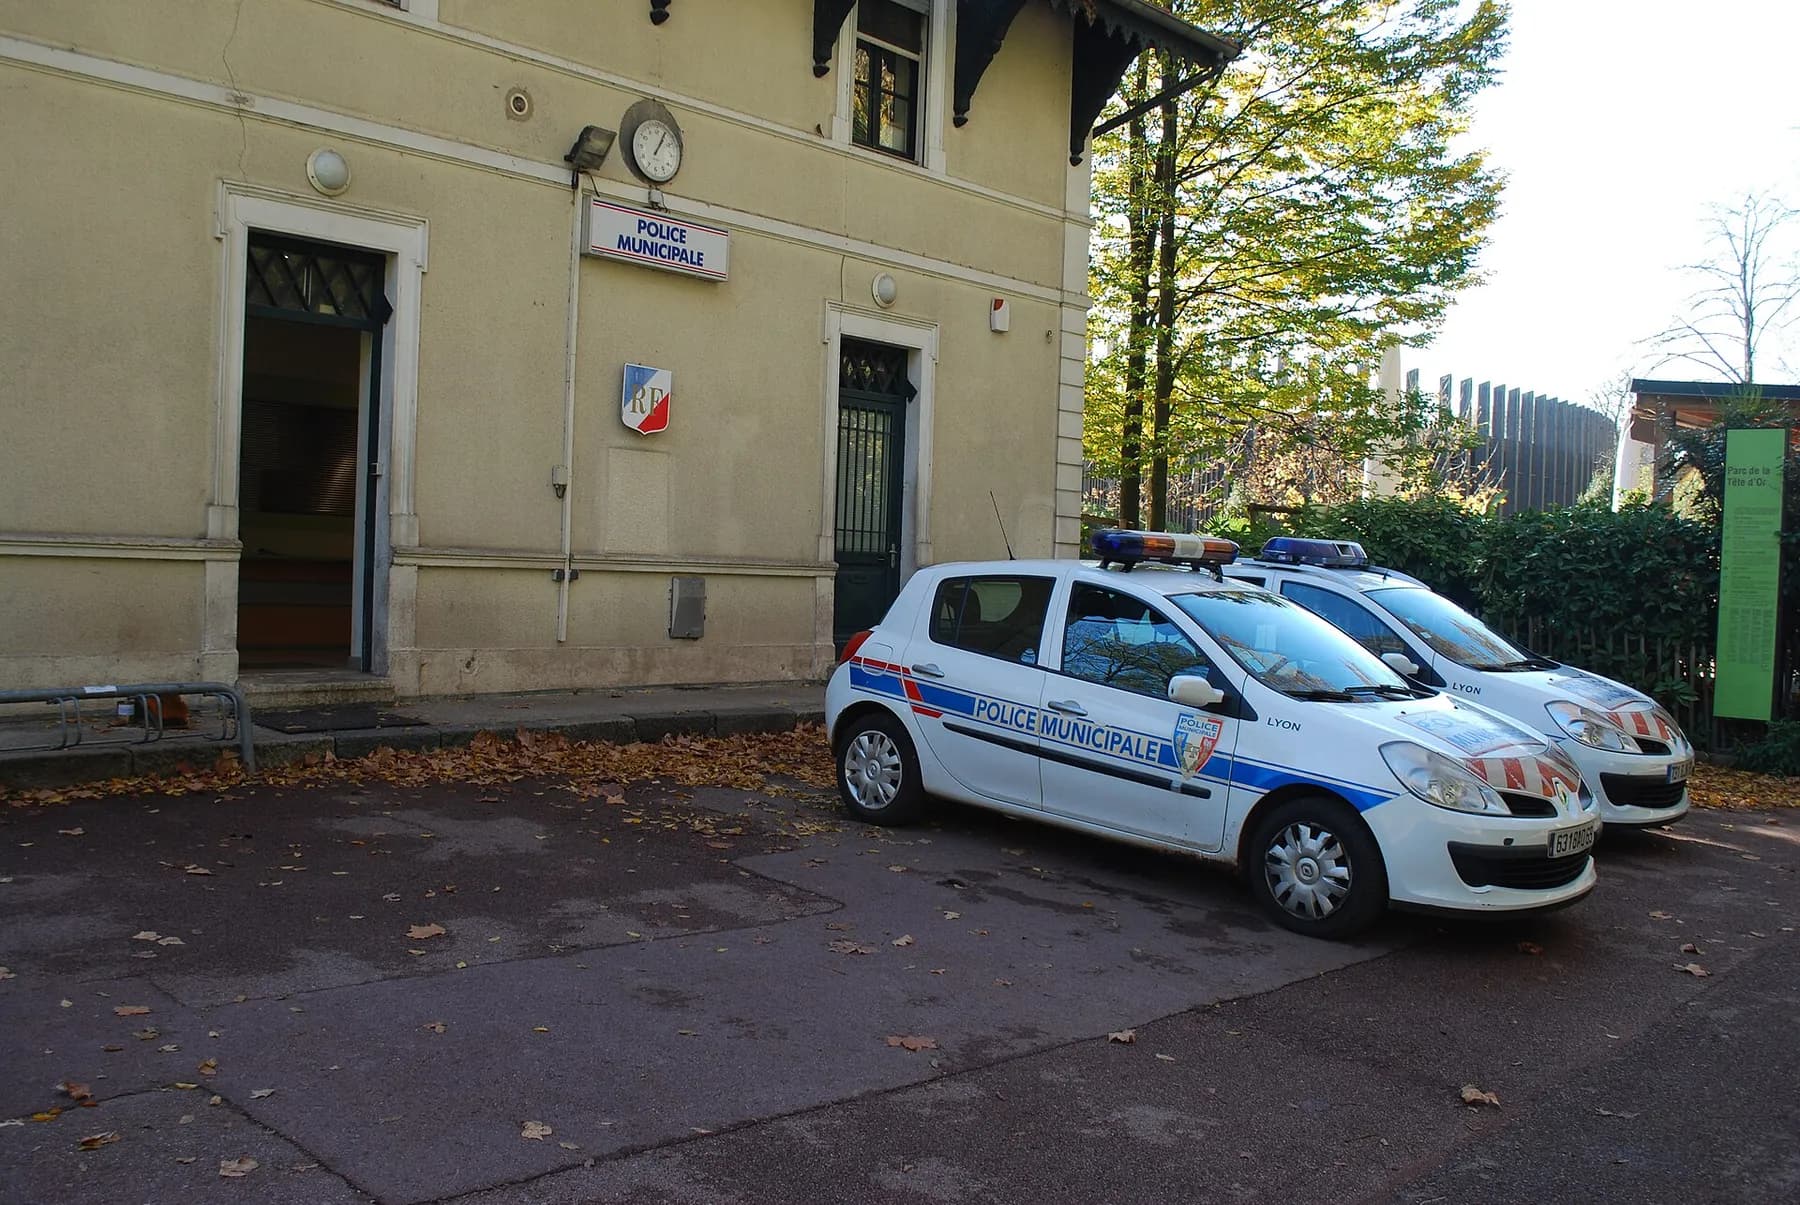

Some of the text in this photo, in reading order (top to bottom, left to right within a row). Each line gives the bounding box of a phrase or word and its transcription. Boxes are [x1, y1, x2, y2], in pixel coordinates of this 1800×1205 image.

[637, 218, 687, 244] POLICE
[617, 234, 704, 267] MUNICIPALE
[630, 383, 664, 417] RF
[1727, 465, 1770, 475] Parc de la
[1452, 682, 1481, 694] LYON
[976, 699, 1158, 762] POLICE MUNICIPALE
[1180, 717, 1218, 732] POLICE
[1267, 716, 1301, 731] LYON
[1179, 726, 1217, 737] MUNICIPALE
